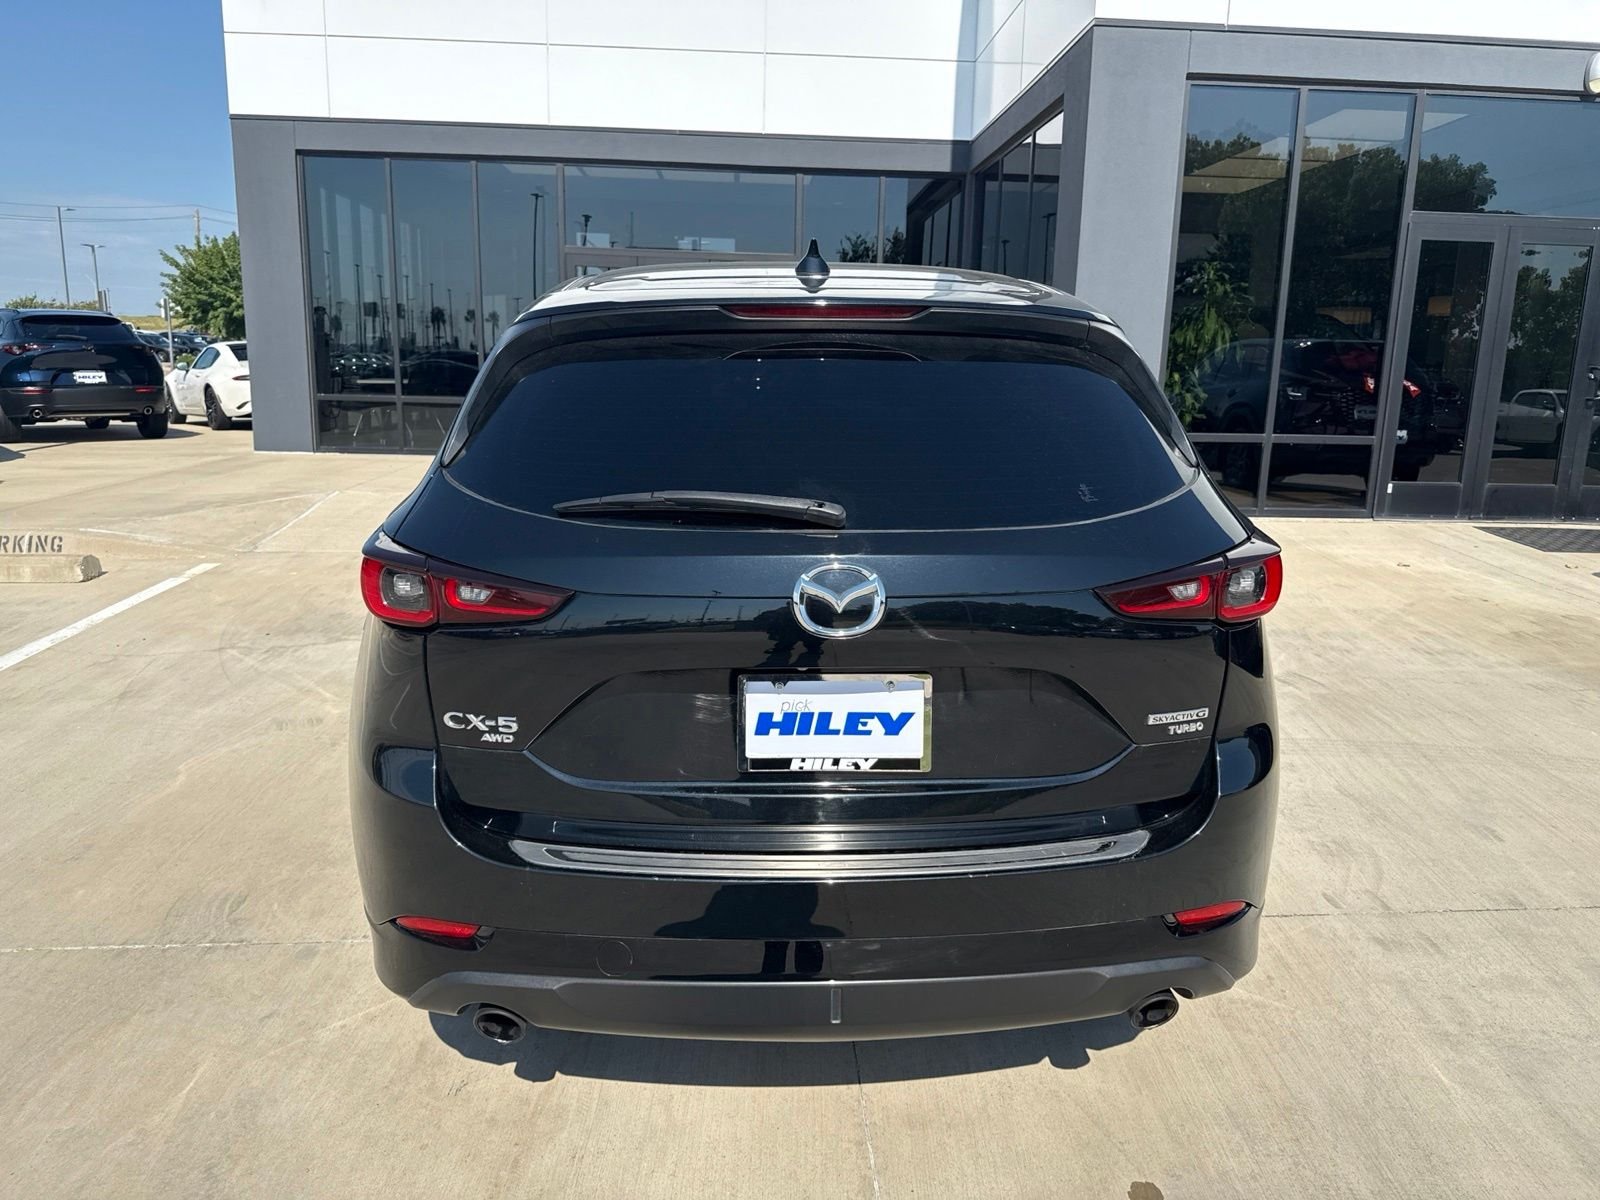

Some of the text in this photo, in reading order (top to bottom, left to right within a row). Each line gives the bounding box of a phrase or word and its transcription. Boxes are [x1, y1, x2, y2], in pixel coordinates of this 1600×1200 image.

[780, 699, 812, 713] pick
[443, 711, 519, 733] CX-5
[754, 711, 916, 736] HILEY
[1168, 721, 1204, 735] TURBO
[480, 733, 515, 743] AWD
[789, 757, 878, 770] HILEY
